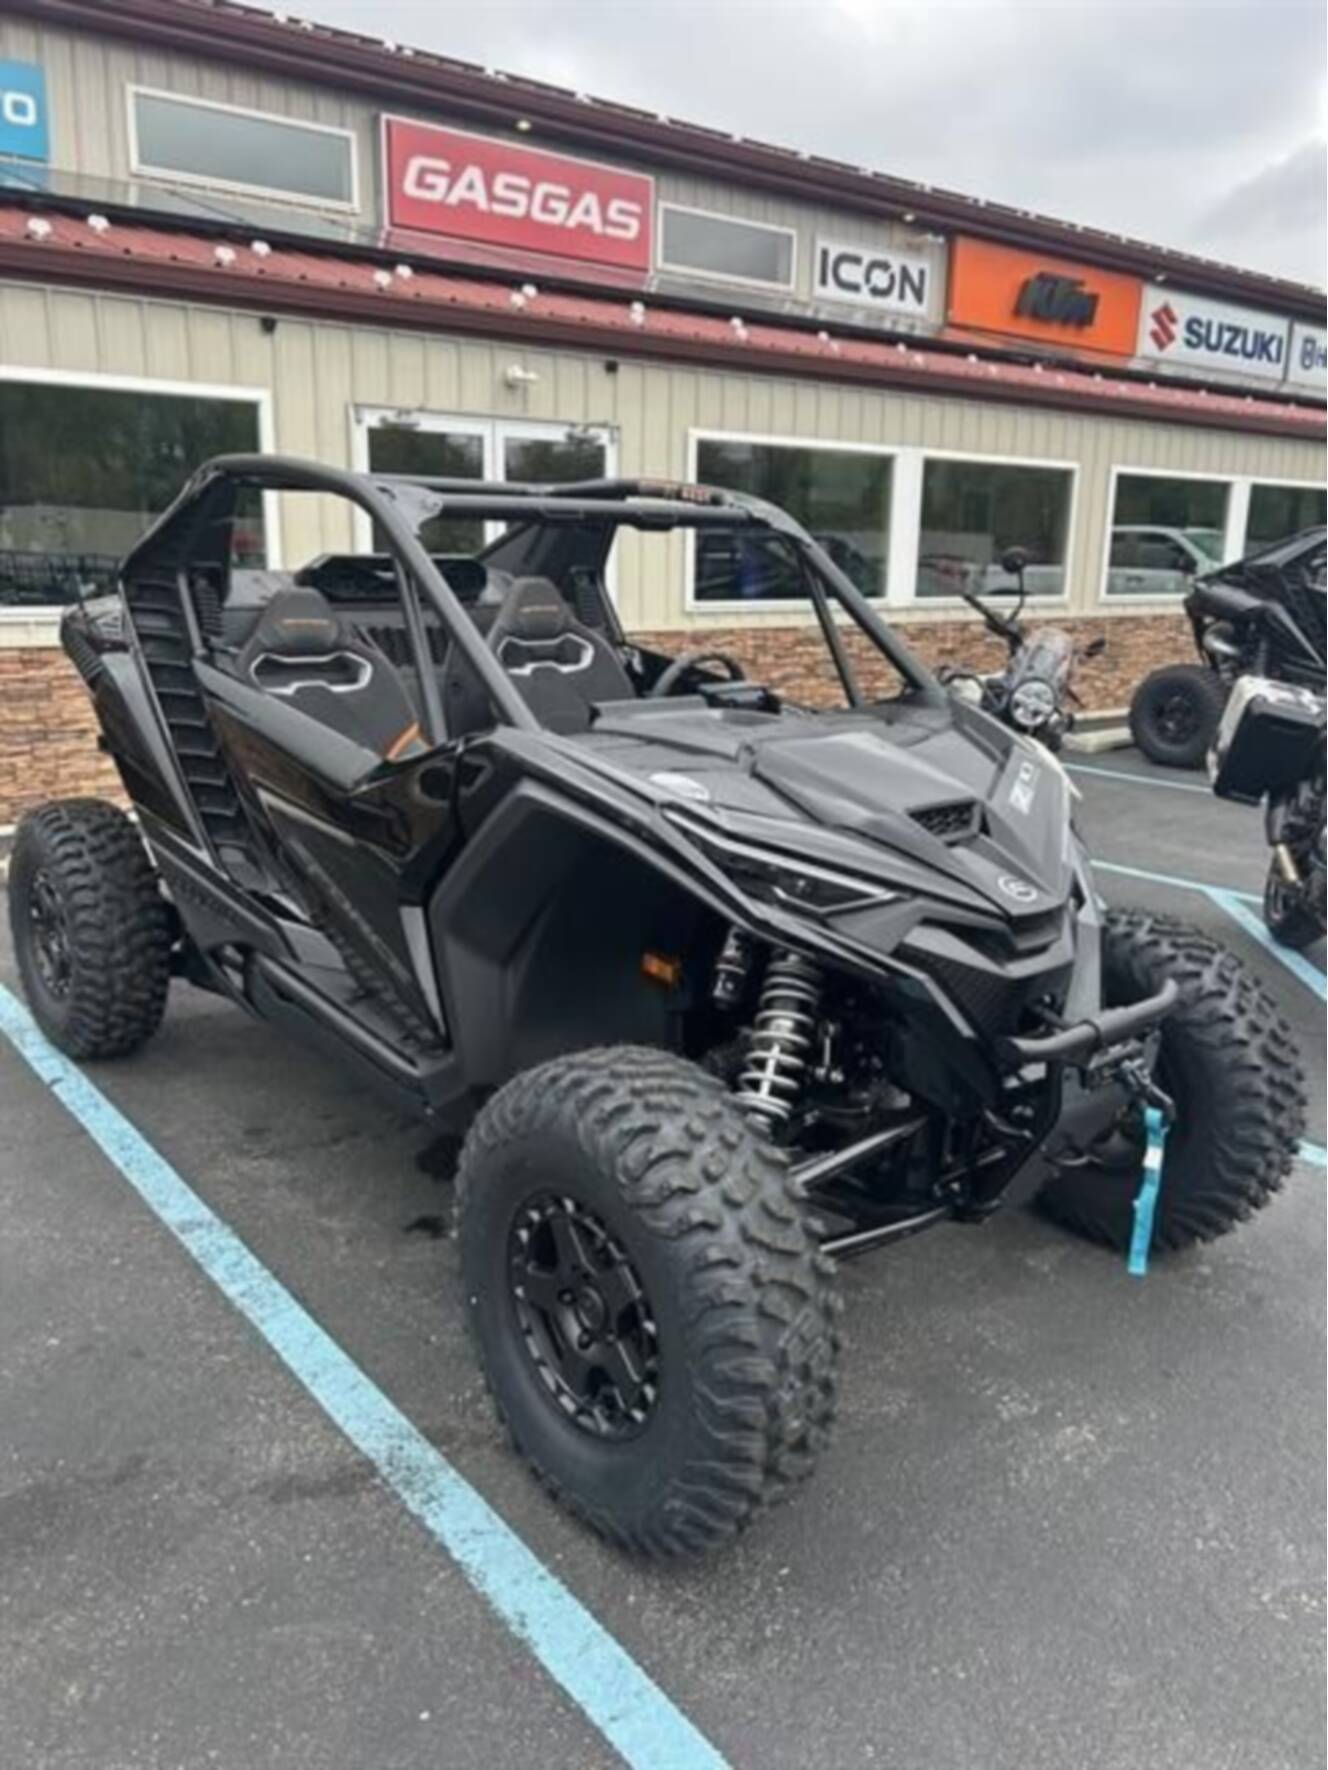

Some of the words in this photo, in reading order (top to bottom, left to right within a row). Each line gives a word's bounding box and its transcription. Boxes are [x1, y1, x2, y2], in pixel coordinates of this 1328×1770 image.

[402, 155, 643, 241] GASGAS
[819, 247, 926, 306] ICON
[1183, 314, 1284, 365] SUZUKI
